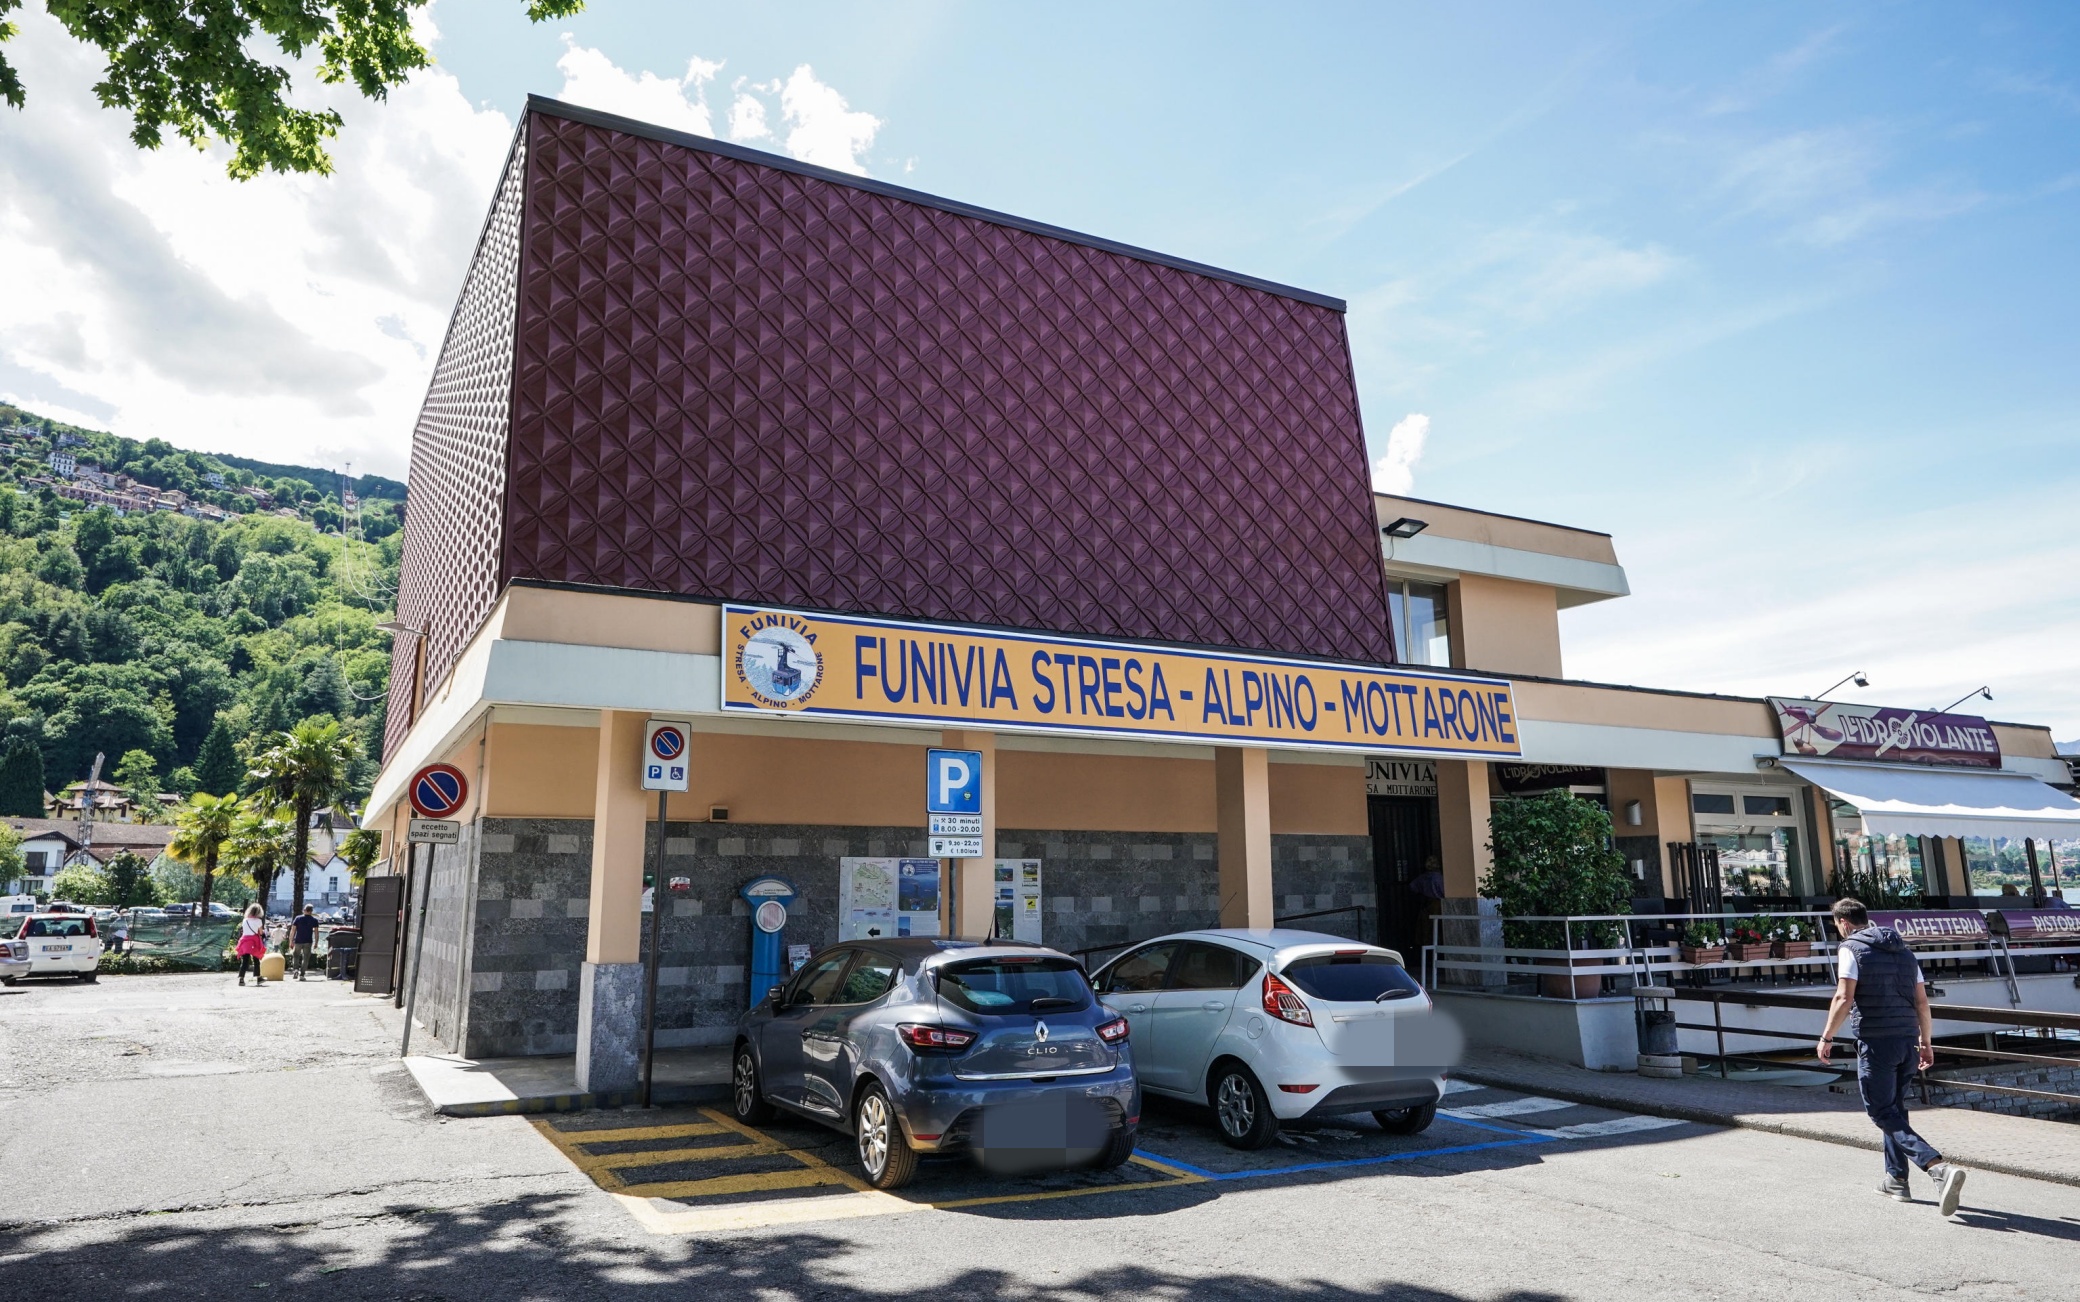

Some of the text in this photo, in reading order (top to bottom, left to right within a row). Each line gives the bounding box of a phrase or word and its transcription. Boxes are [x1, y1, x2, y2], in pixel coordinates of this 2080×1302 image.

[740, 614, 817, 645] FUNIVIA
[735, 643, 825, 709] STRESA ALPINO MOTTARONE
[855, 635, 1018, 711] FUNIVIA
[1031, 650, 1175, 721] STRESA
[1203, 667, 1317, 732] ALPINO
[1340, 679, 1515, 744] MOTTARONE
[1838, 713, 1994, 753] L'IDROVOLANTE
[651, 767, 660, 778] P
[940, 758, 970, 804] P
[1387, 784, 1437, 796] MOTTARONE
[431, 832, 457, 840] segnati
[1894, 917, 1984, 937] CAFFETTERIA
[1027, 1046, 1058, 1055] CLIO
